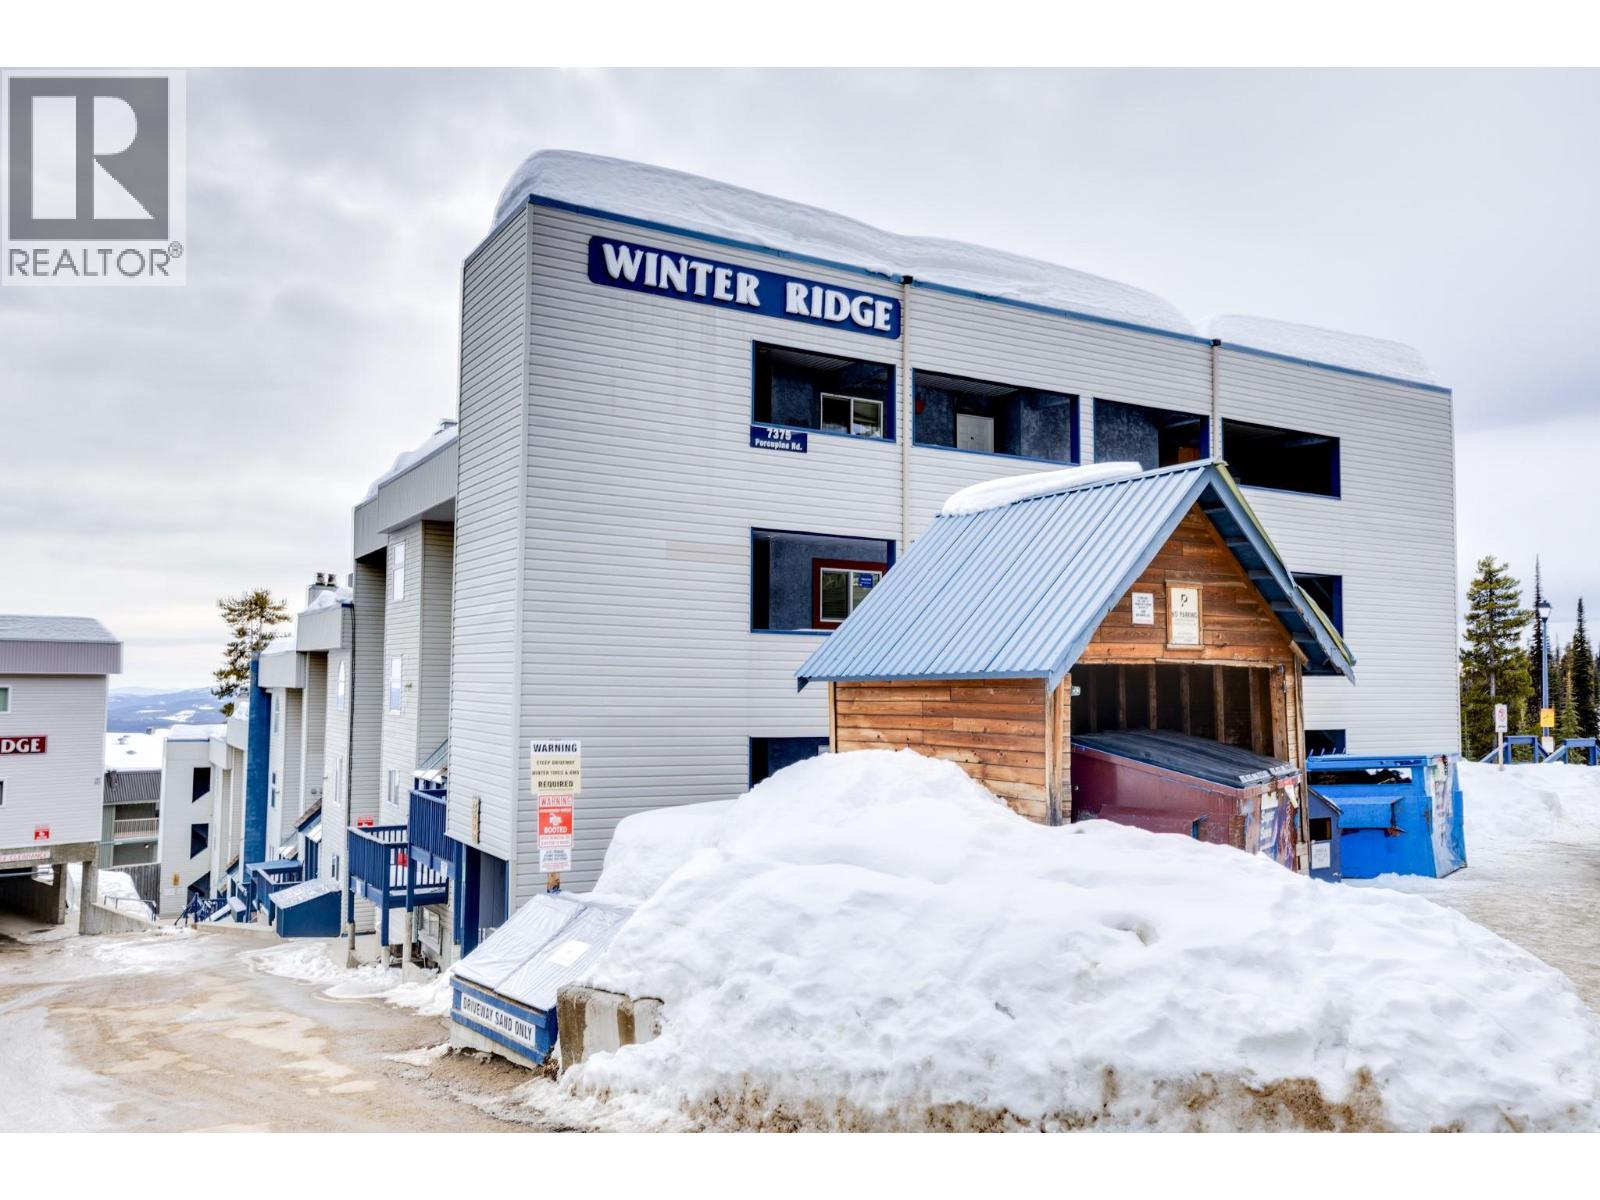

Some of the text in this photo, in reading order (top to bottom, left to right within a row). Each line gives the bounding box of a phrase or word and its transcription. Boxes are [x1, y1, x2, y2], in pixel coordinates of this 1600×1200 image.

[602, 242, 894, 331] WINTER RIDGE
[767, 428, 792, 441] 7375
[755, 438, 803, 451] Porcupine Rd.
[533, 744, 577, 753] WARNING
[538, 780, 574, 788] REQUIRED
[463, 997, 533, 1041] DRIVEWAY SAND ONLY
